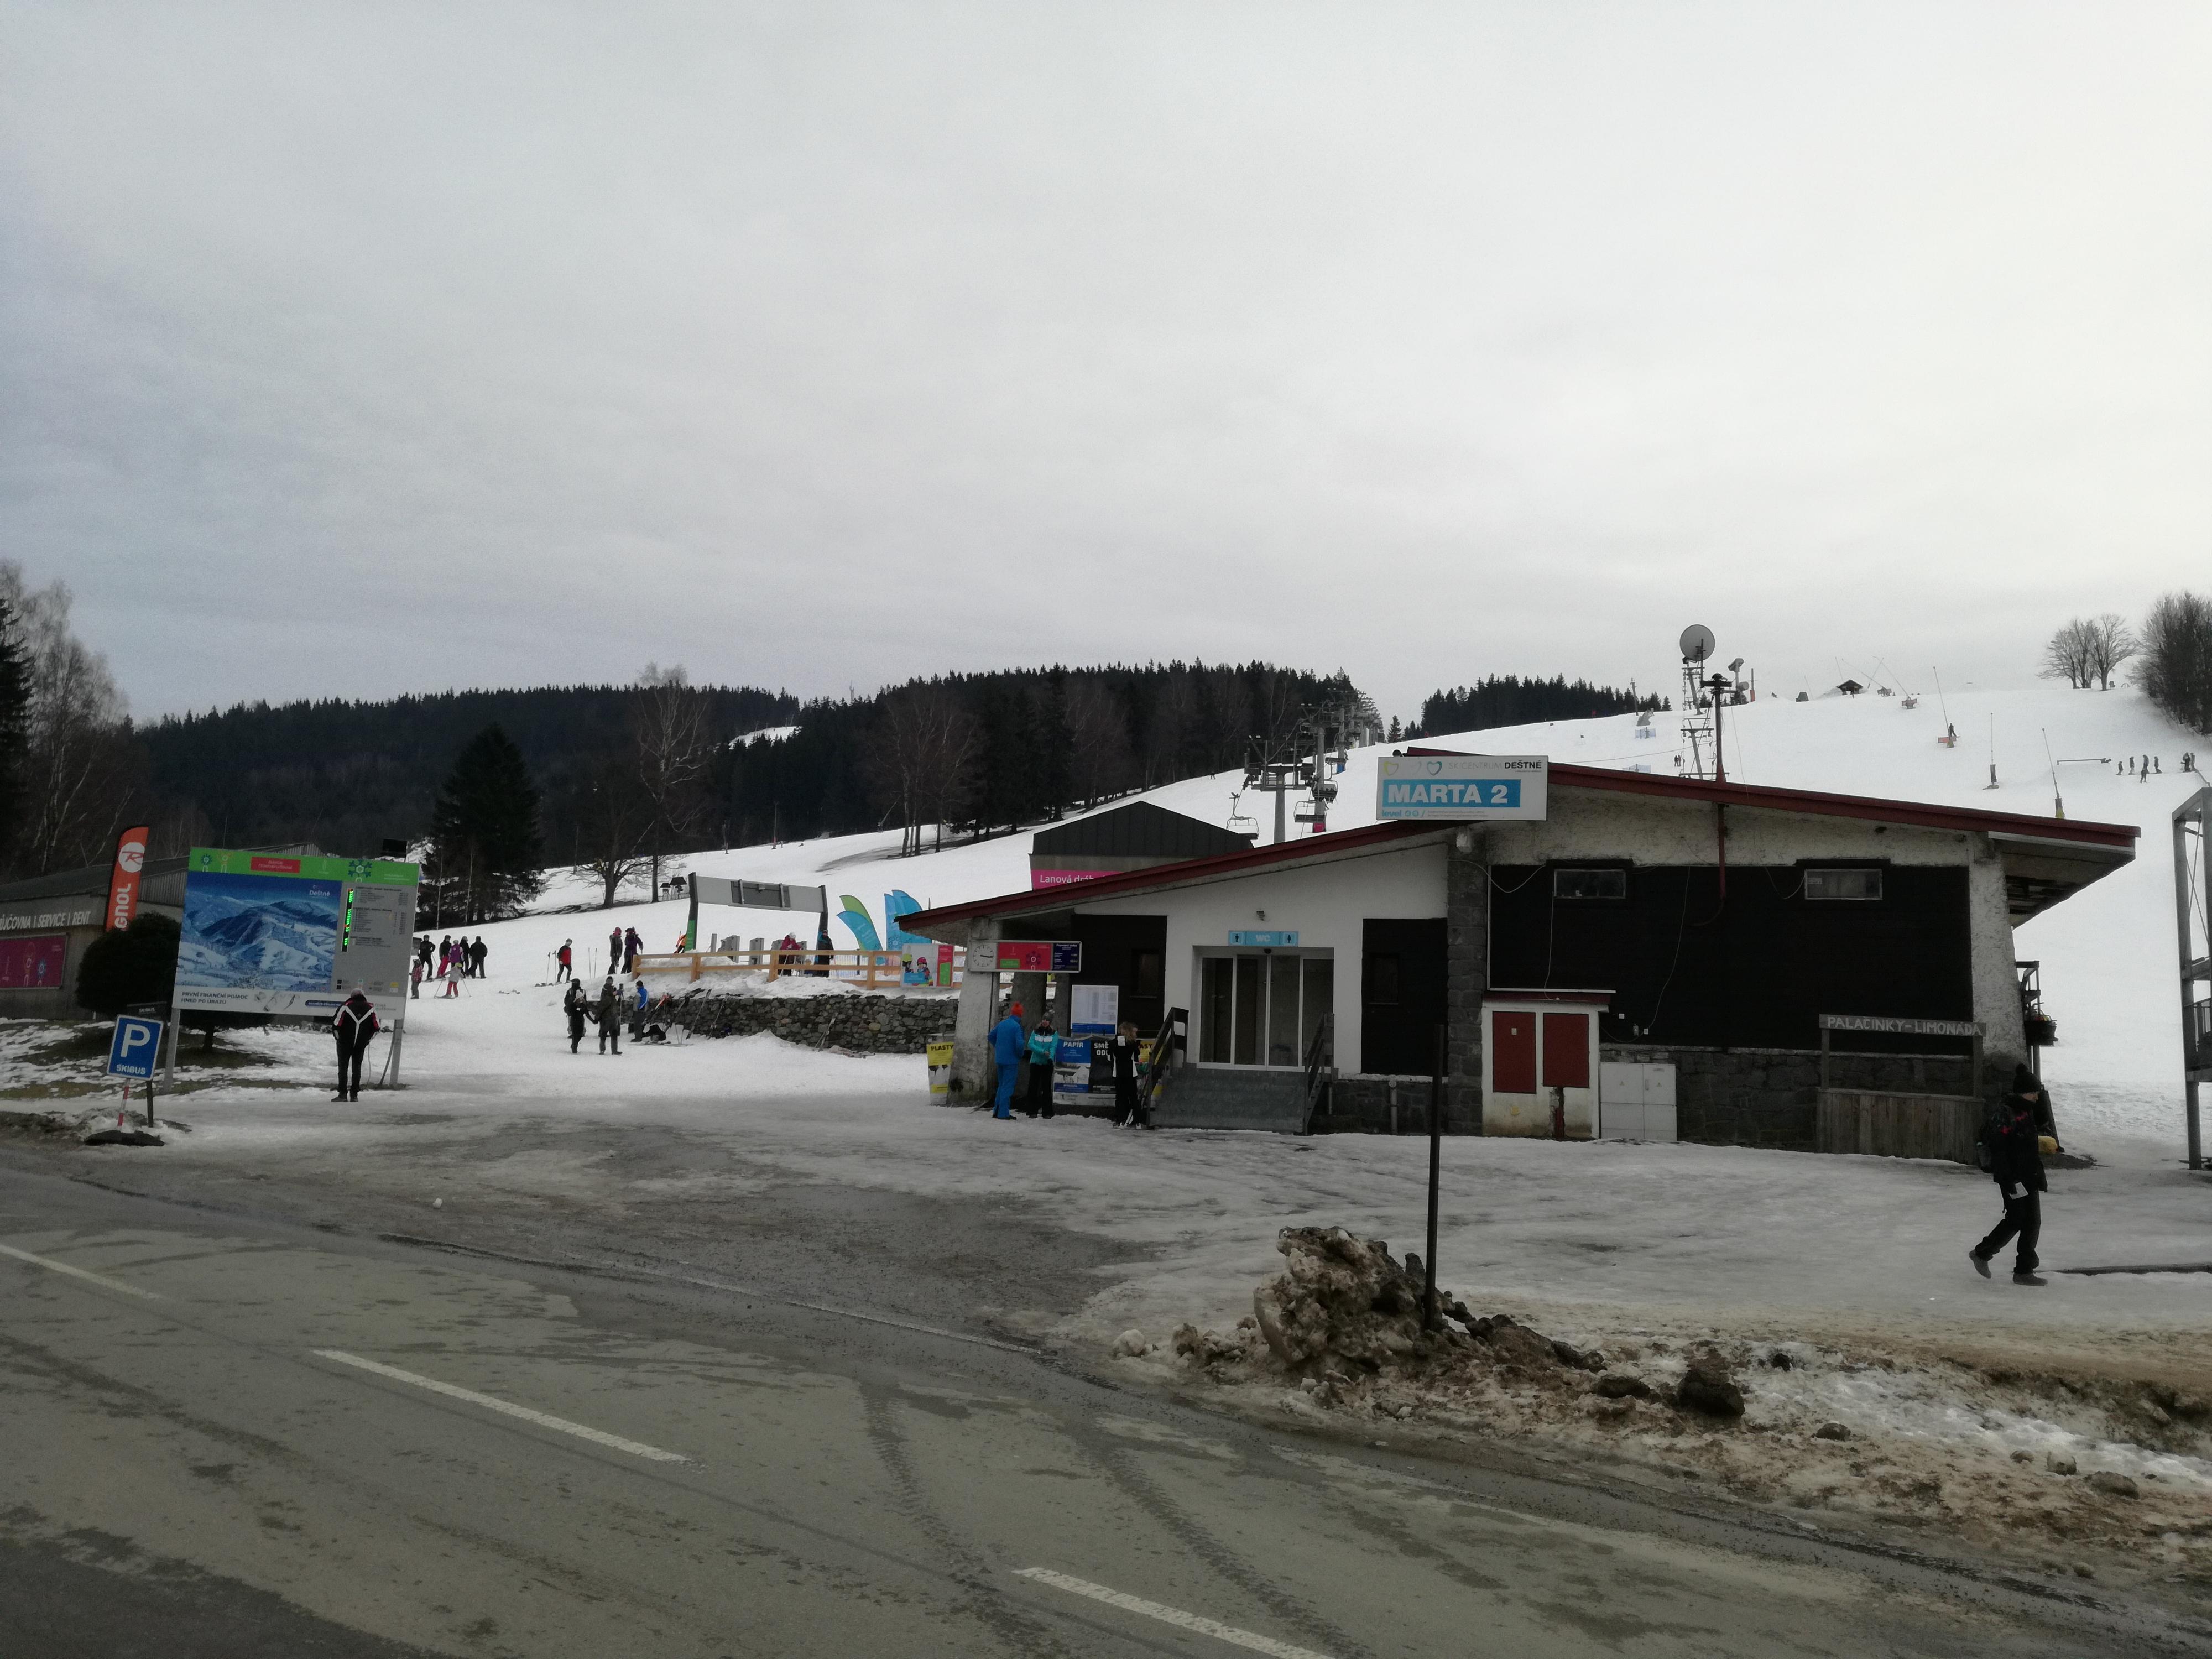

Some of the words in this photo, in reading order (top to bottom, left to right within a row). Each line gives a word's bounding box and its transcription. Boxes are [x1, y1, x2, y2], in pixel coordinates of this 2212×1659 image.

[1448, 761, 1502, 770] SKICENTRUM
[1504, 760, 1542, 769] DEŠTNÉ
[1388, 784, 1482, 804] MARTA
[1490, 785, 1508, 804] 2
[1040, 875, 1072, 884] Lanová
[71, 911, 91, 925] RENT
[121, 1024, 150, 1057] P
[116, 1064, 146, 1075] SKIBUS
